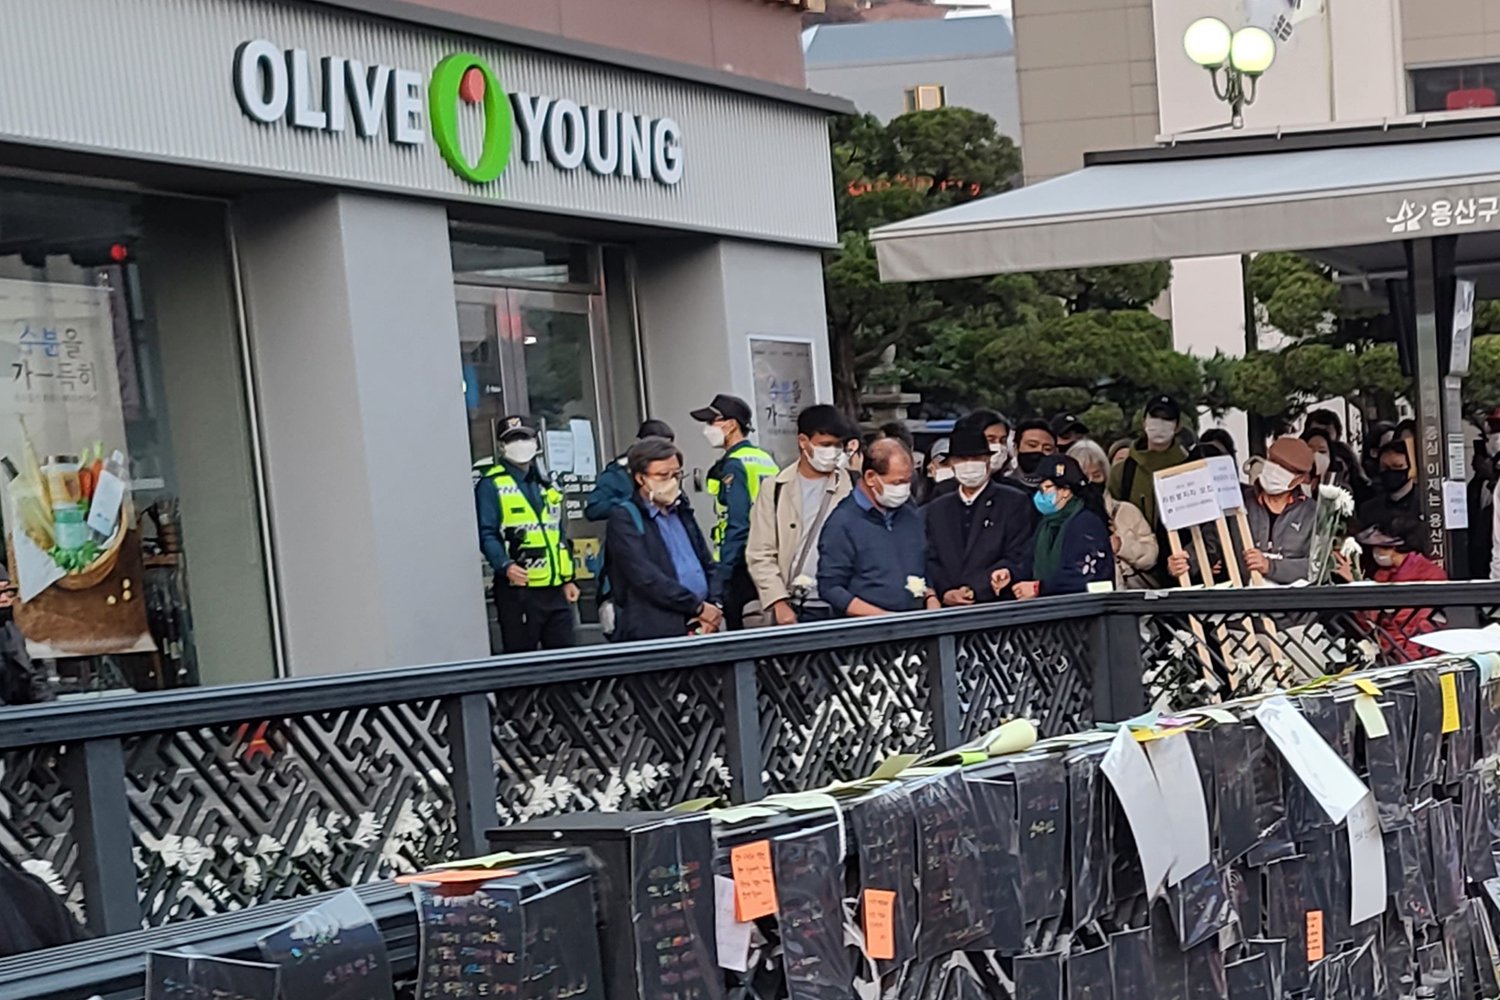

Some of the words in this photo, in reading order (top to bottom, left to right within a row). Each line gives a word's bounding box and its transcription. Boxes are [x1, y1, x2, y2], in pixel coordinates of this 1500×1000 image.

[234, 39, 425, 145] OLIVE
[509, 91, 684, 185] YOUNG
[1431, 197, 1499, 228] 용산구
